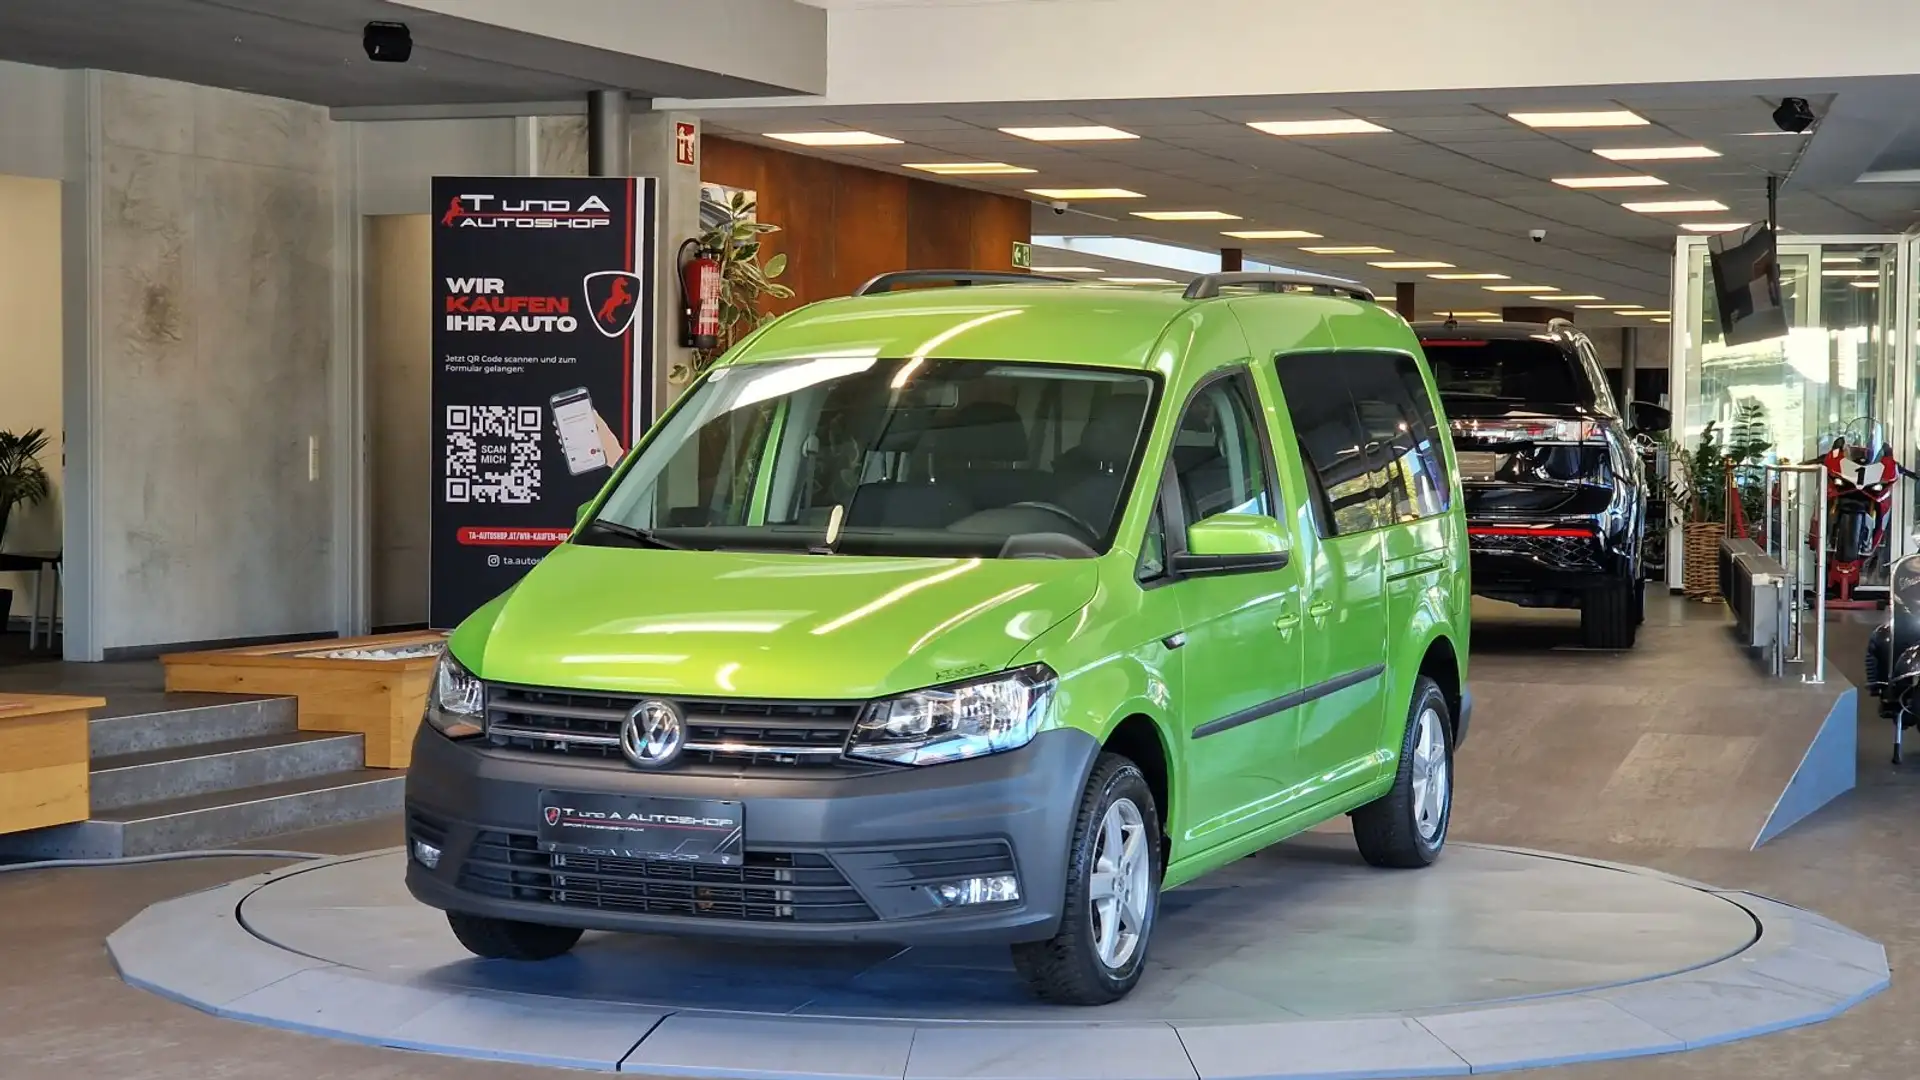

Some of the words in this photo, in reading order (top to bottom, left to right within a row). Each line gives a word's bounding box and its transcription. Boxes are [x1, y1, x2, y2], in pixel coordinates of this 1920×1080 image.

[460, 194, 494, 211] T
[577, 195, 610, 212] A
[460, 217, 610, 229] AUTOSHOP
[446, 277, 504, 294] WIR
[446, 296, 569, 313] KAUFEN
[446, 315, 496, 332] IHR
[498, 315, 578, 333] AUTO
[445, 354, 465, 363] Jetzt
[467, 355, 480, 364] QR
[481, 355, 502, 364] Code
[504, 356, 539, 364] scannen
[540, 356, 557, 365] und
[445, 364, 482, 372] Formular
[484, 365, 525, 374] gelangen:
[481, 445, 507, 454] SCAN
[481, 455, 507, 464] MICH
[562, 808, 576, 816] T
[609, 811, 622, 820] A
[627, 813, 734, 826] AUTOSHOP
